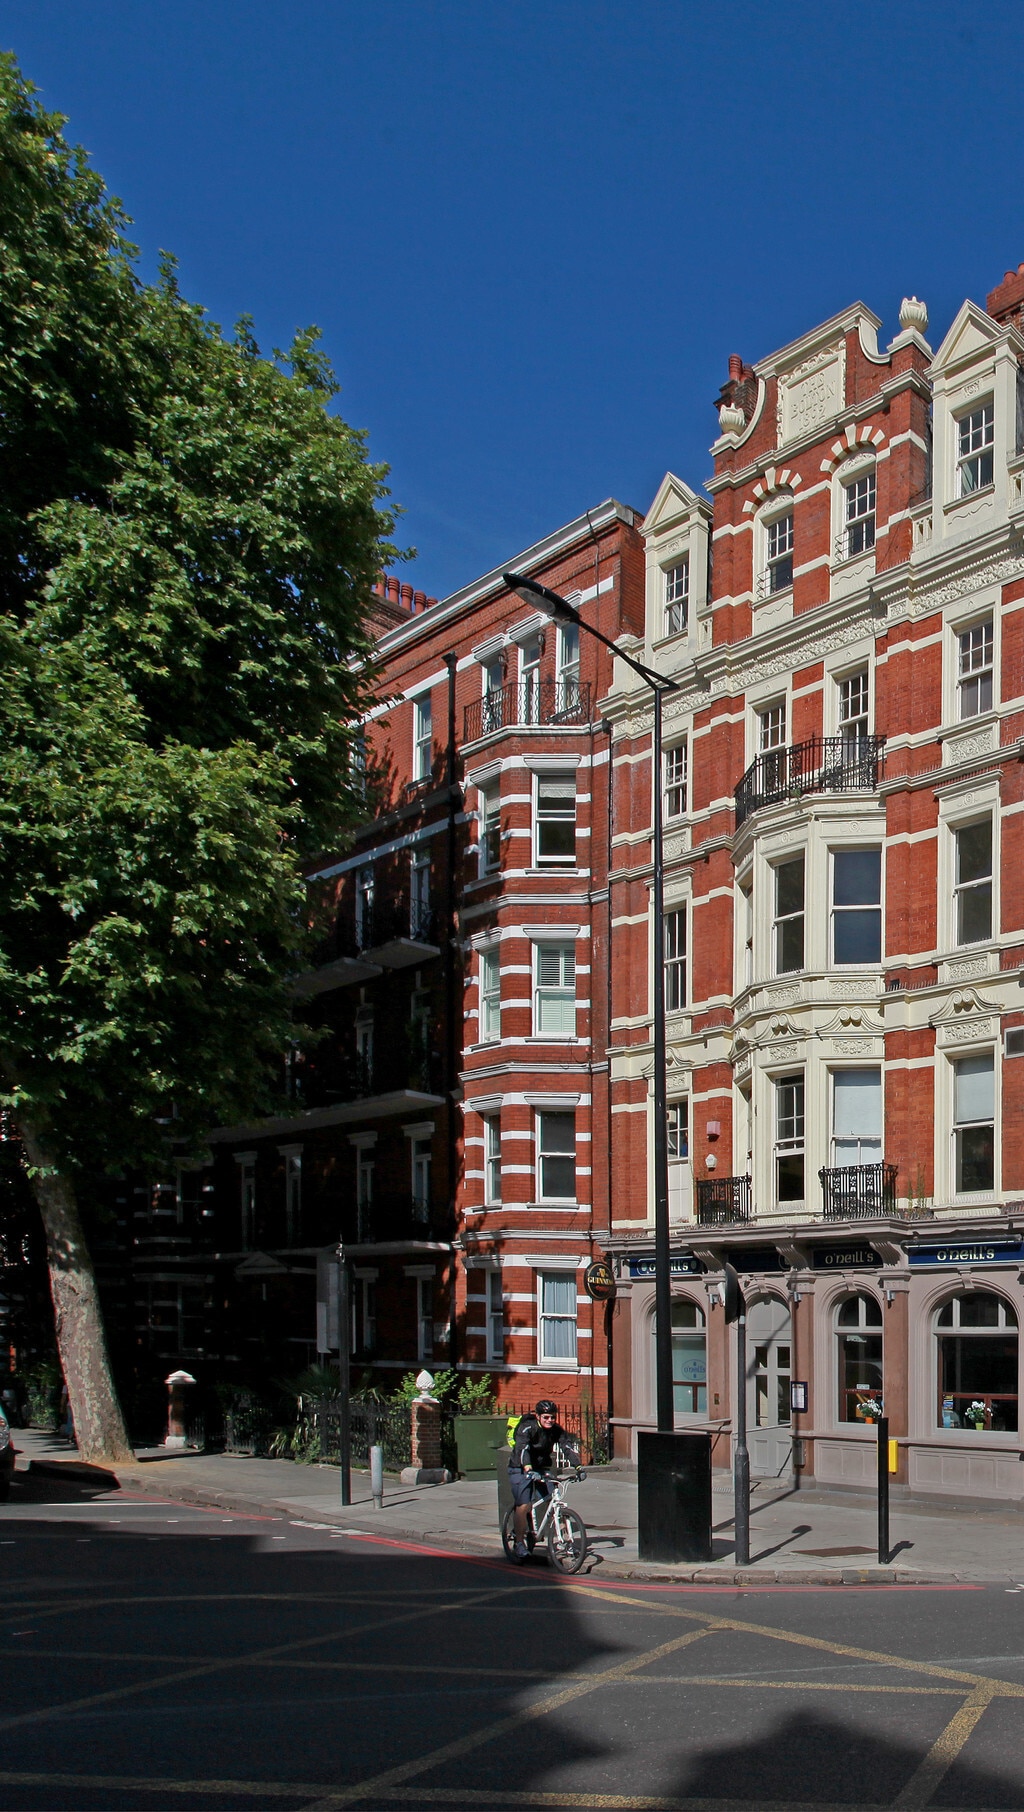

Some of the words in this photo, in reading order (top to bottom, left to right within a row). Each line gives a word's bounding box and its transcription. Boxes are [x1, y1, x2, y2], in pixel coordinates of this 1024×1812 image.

[790, 381, 836, 419] BOLTON
[824, 1251, 875, 1265] o'neill's
[936, 1246, 995, 1261] o'neill's
[648, 1259, 689, 1272] oill's
